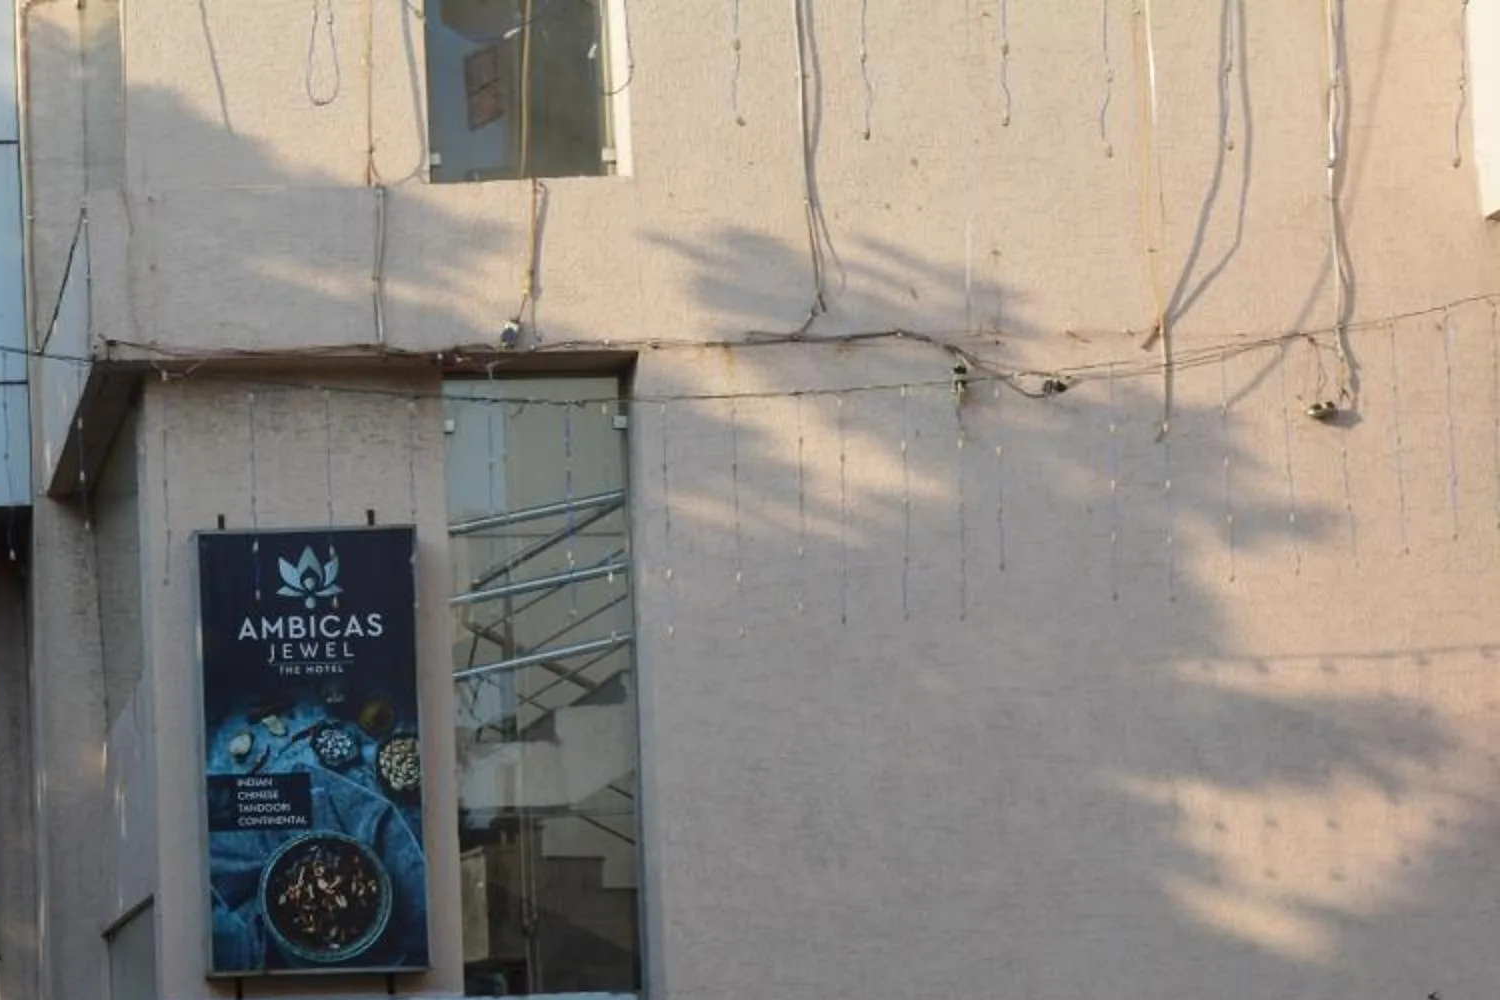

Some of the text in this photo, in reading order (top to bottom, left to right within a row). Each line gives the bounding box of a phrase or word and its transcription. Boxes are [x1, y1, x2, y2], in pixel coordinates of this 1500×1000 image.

[238, 613, 384, 641] AMBICAS
[268, 641, 356, 664] JEWEL
[279, 664, 345, 676] THE HOTEL
[238, 815, 308, 827] CONTINENTAL
